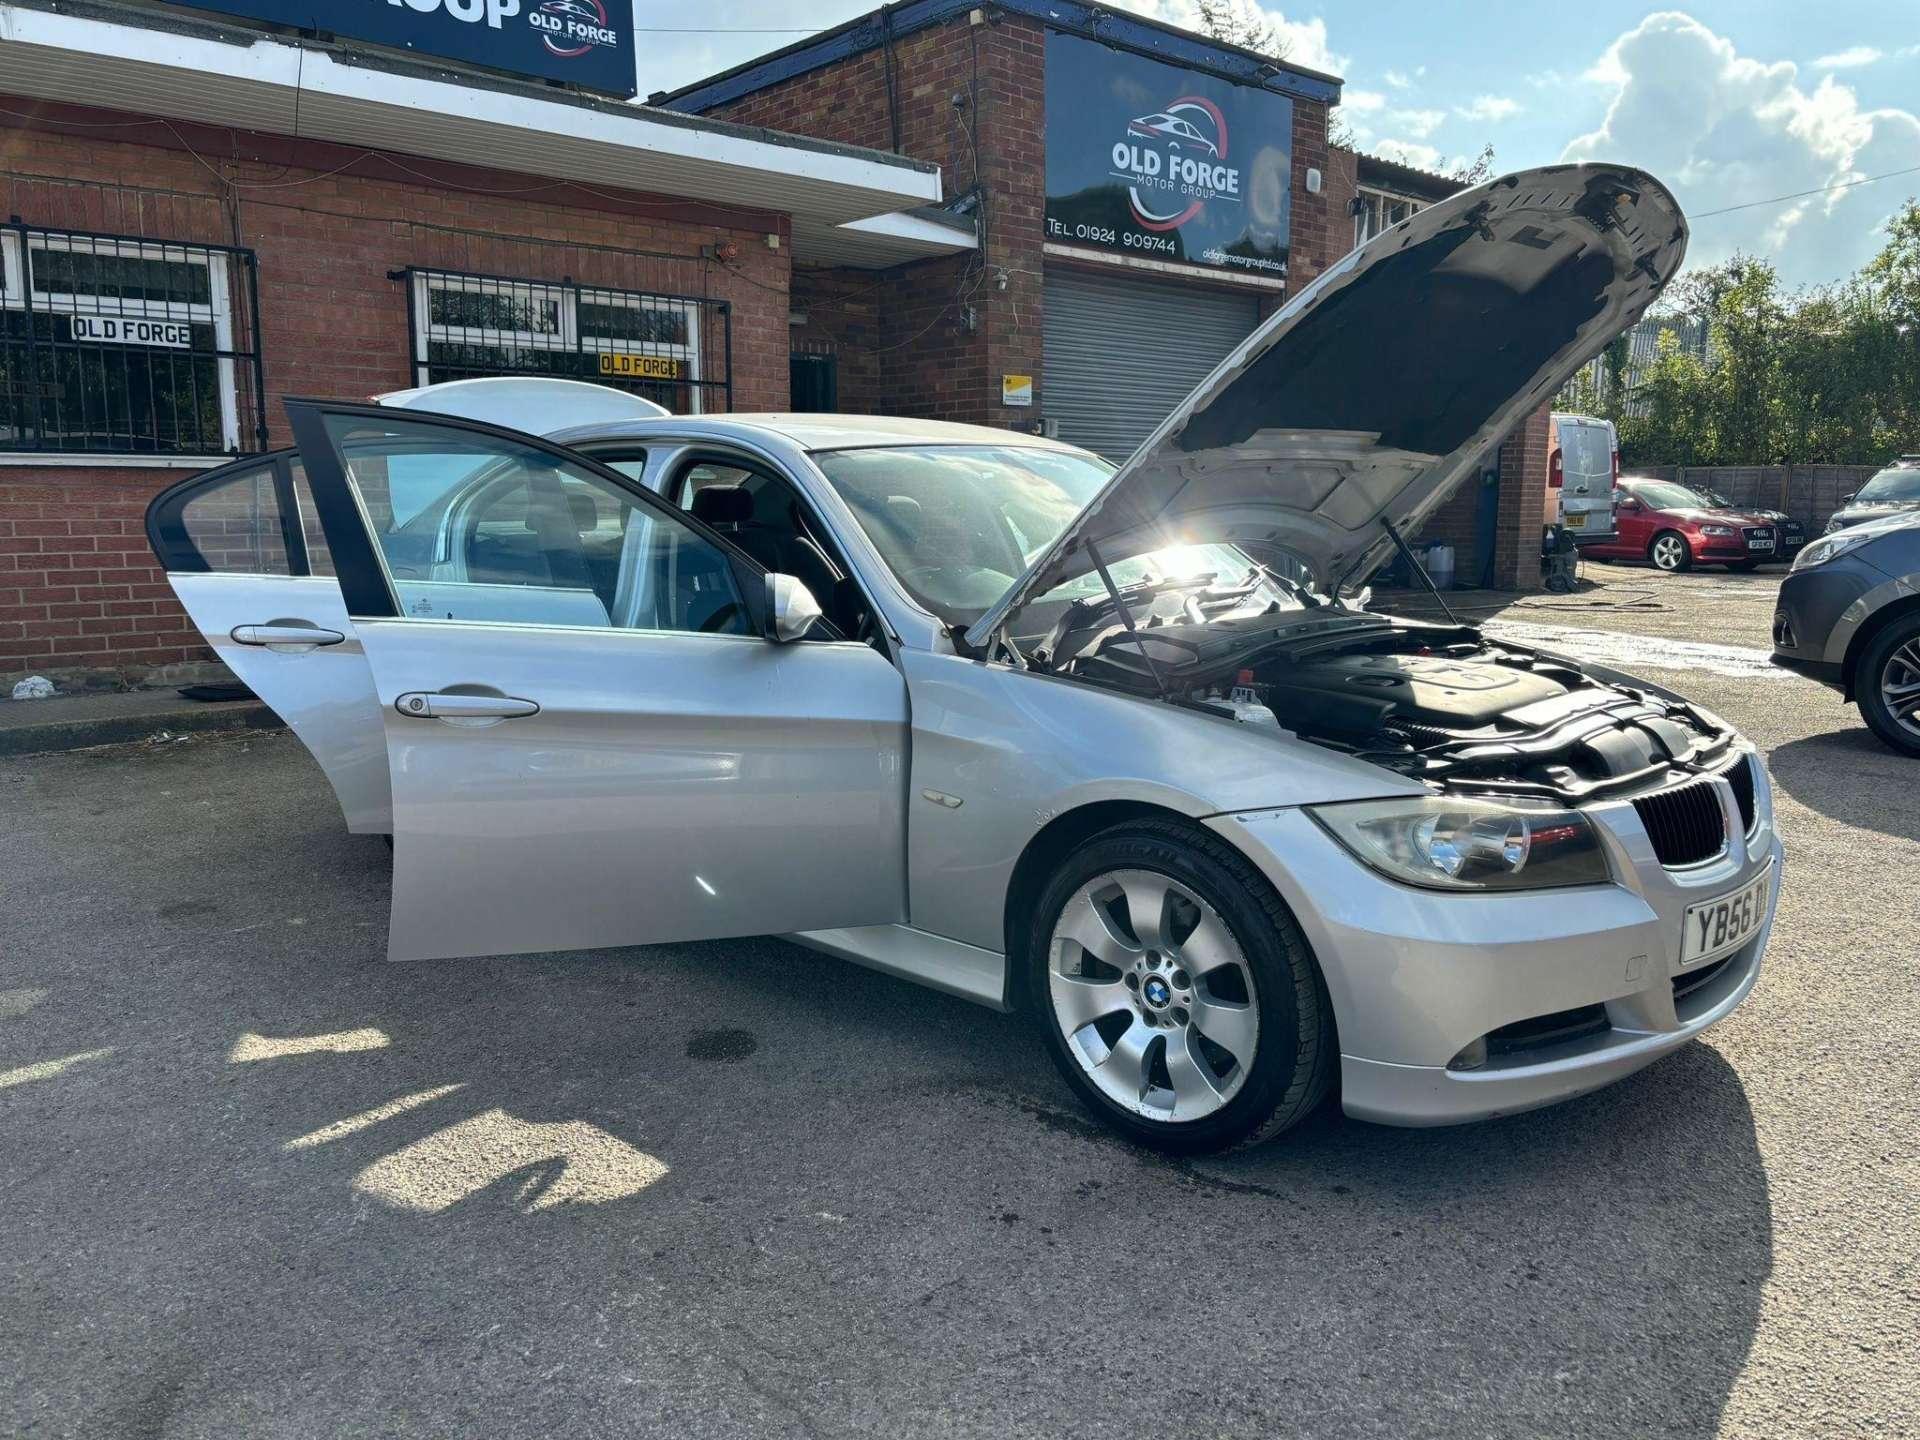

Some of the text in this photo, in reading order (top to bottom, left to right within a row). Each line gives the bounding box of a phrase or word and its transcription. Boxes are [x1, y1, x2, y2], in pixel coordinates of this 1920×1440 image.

[528, 12, 617, 44] OLD FORGE
[1112, 142, 1239, 193] OLD FORGE
[1137, 174, 1217, 199] MOTOR GROUP
[1076, 224, 1116, 243] 01924
[1123, 231, 1176, 255] 909744
[73, 318, 190, 344] OLD FORGE
[601, 355, 676, 376] OLD FORGE
[1699, 891, 1752, 953] YB56
